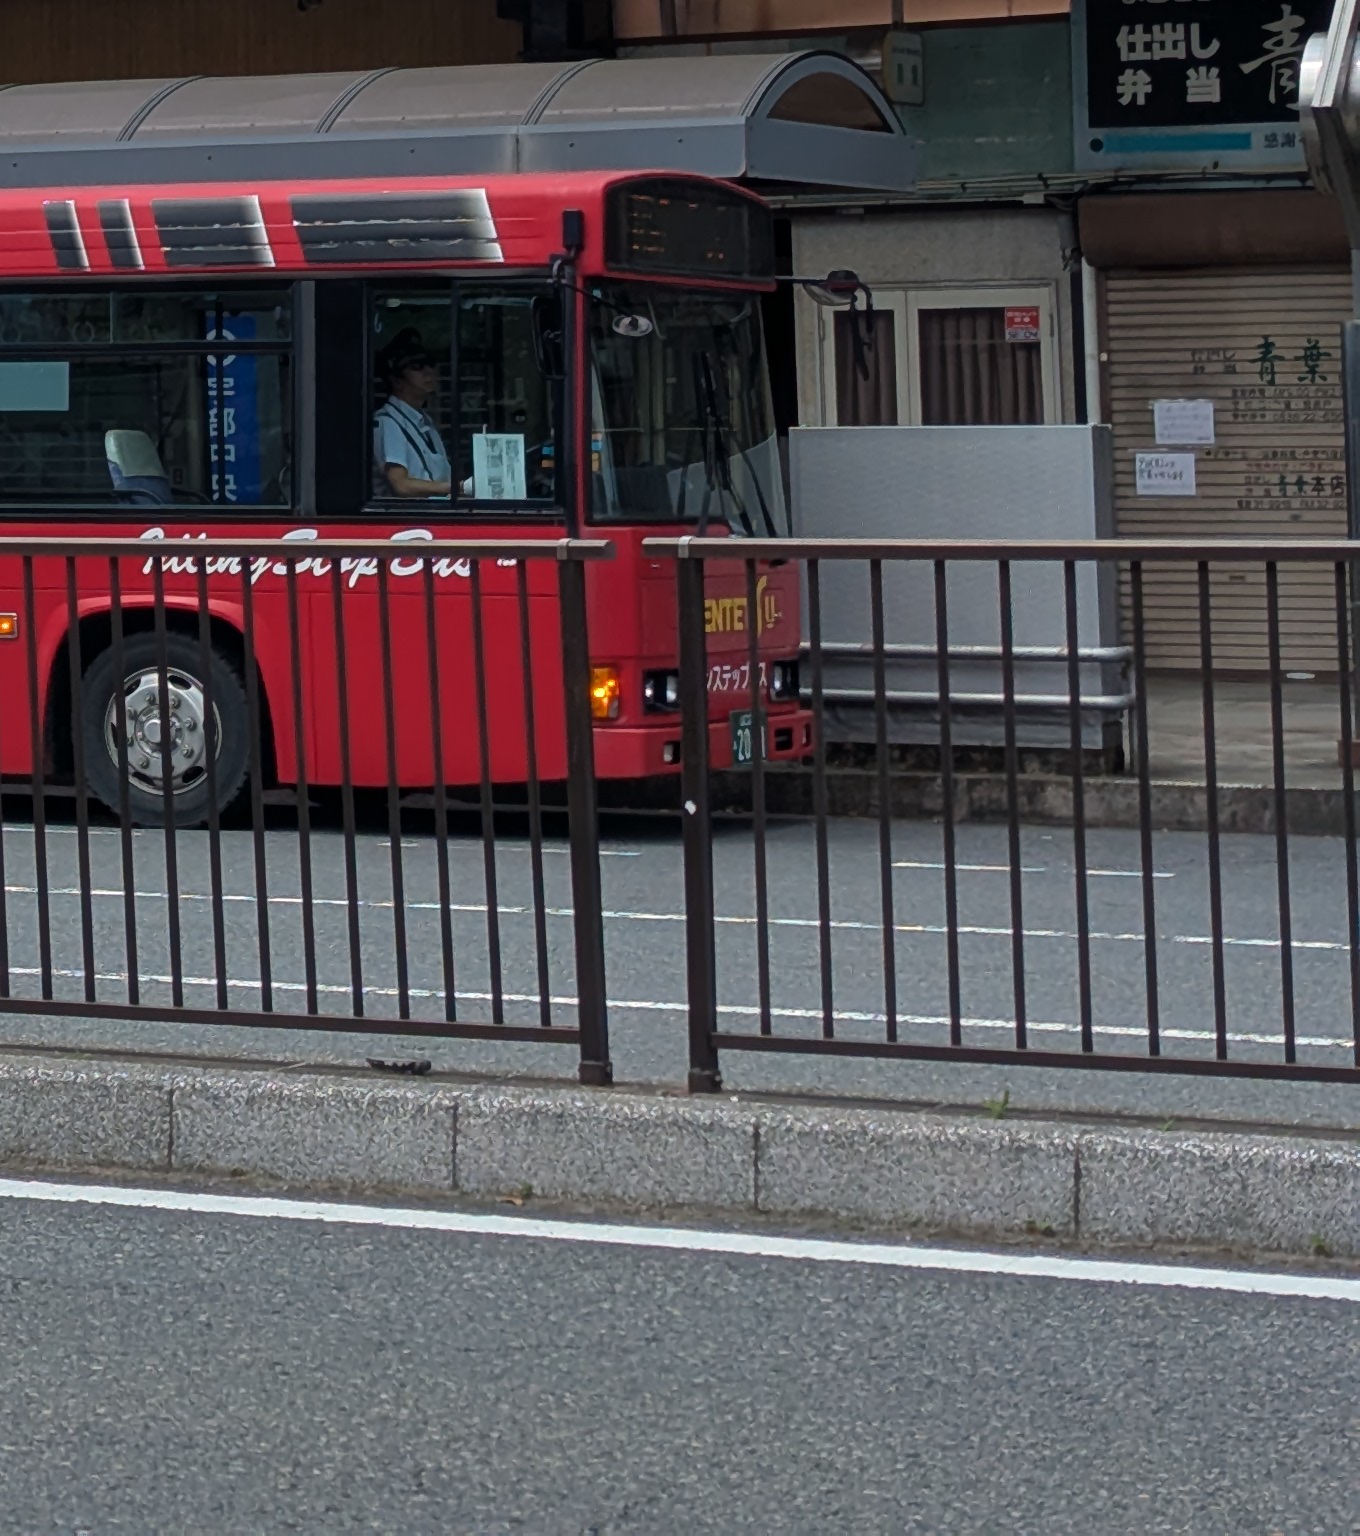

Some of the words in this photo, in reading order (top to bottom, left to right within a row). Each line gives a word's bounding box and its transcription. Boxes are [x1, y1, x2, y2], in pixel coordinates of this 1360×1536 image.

[1116, 22, 1220, 62] 仕出し
[1116, 66, 1221, 106] 弁当
[1247, 334, 1332, 386] 青葉
[706, 661, 768, 692] ンステップス
